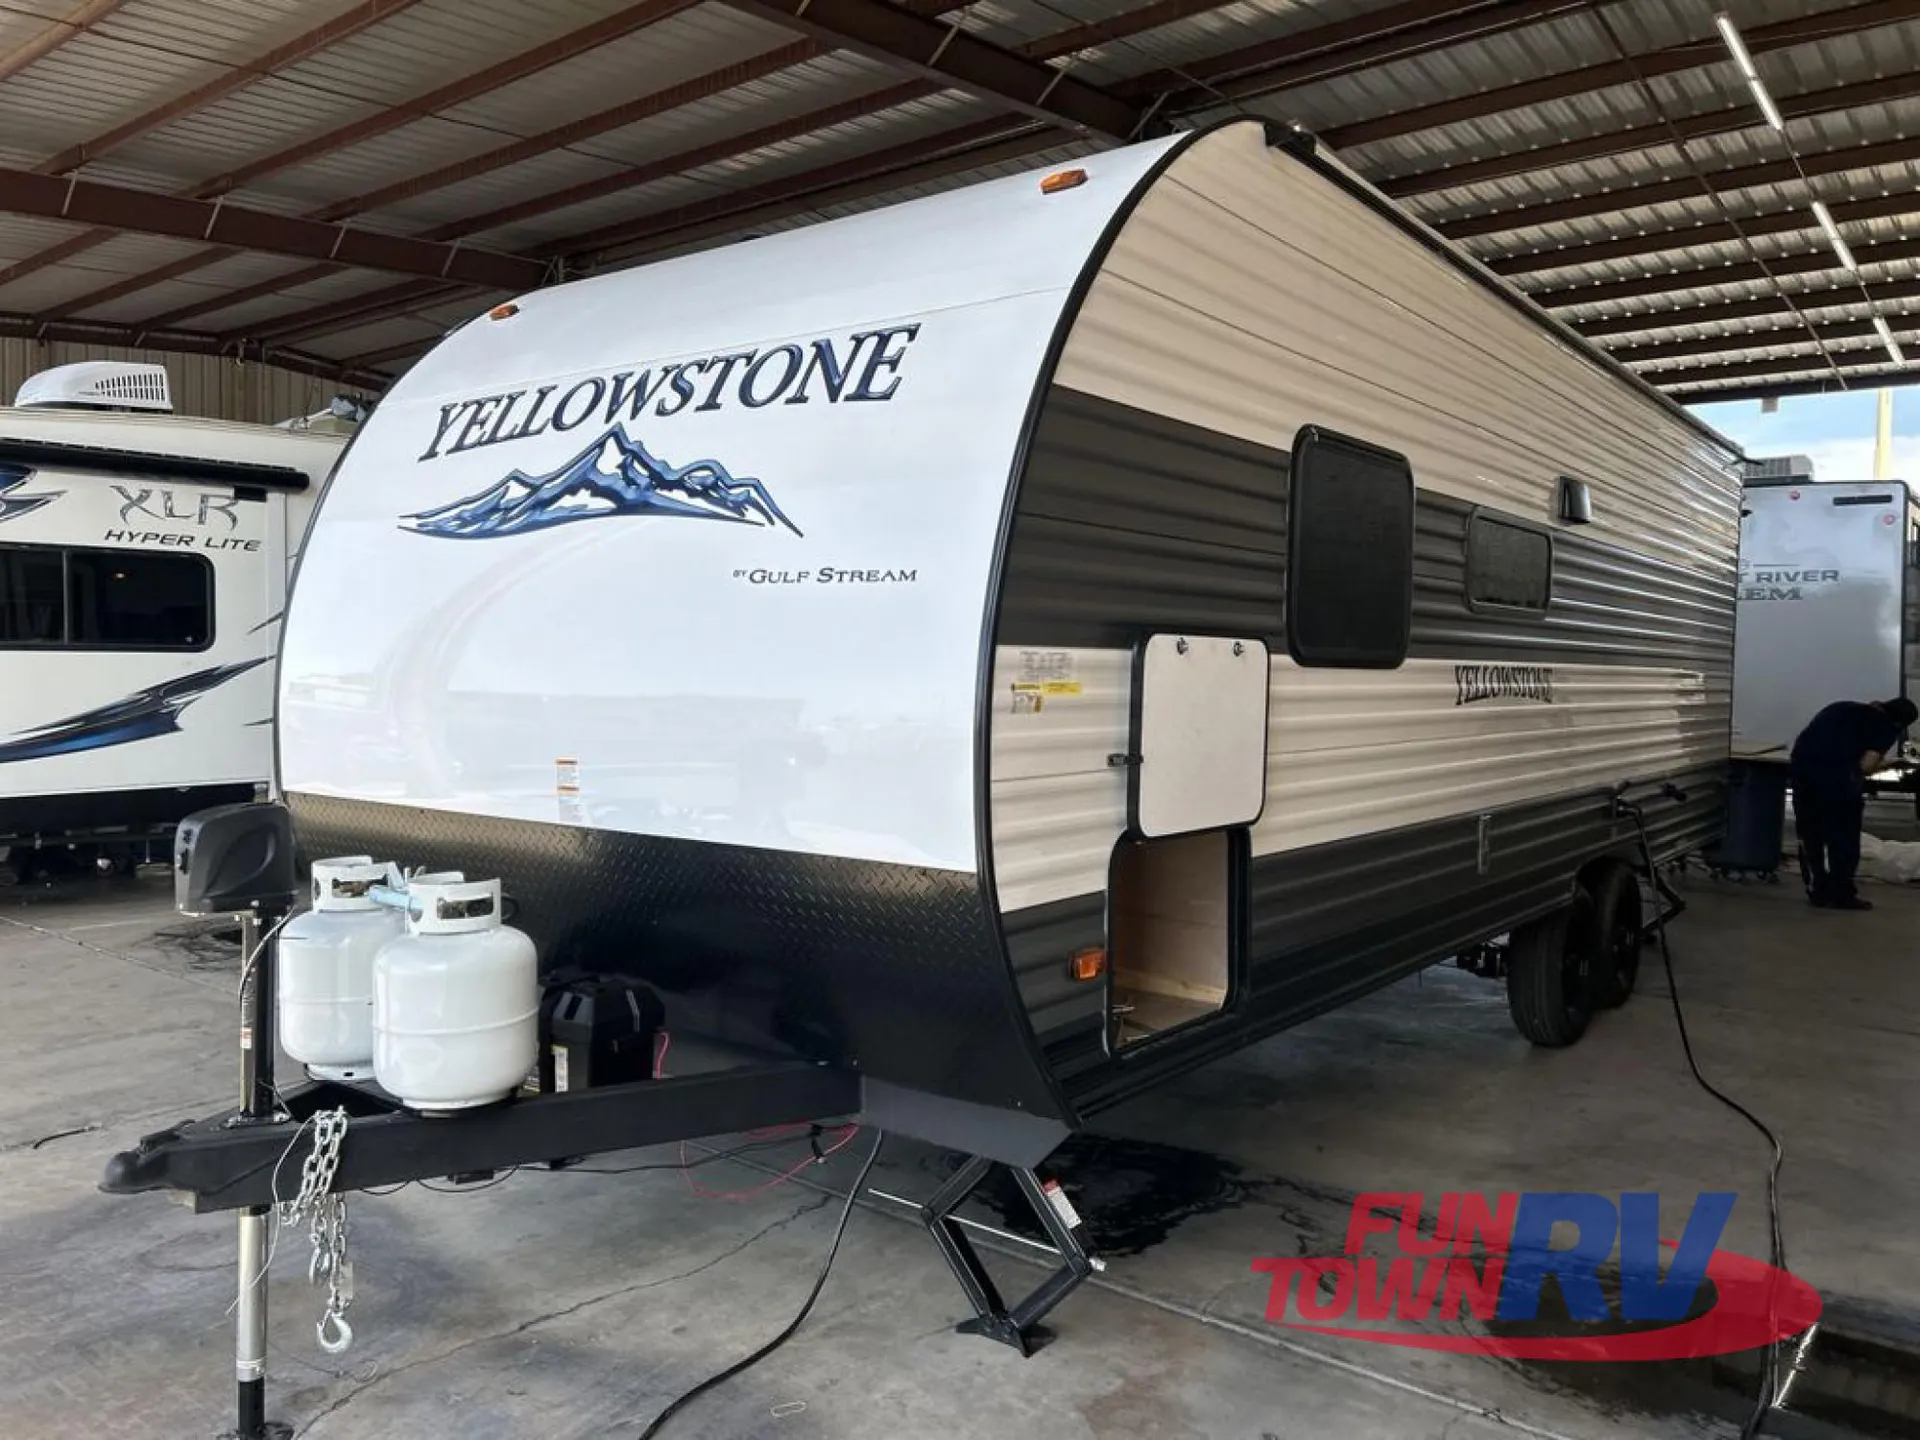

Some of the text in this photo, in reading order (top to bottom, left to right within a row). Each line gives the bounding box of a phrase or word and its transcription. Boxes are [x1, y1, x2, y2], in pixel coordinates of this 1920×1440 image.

[417, 322, 922, 462] YELLOWSTONE
[109, 485, 239, 531] XLR
[104, 528, 262, 552] HYPER LITE
[732, 567, 918, 584] BY GULF STREAM
[1756, 569, 1839, 583] RIVER
[1454, 665, 1553, 705] YELLOWSTONE
